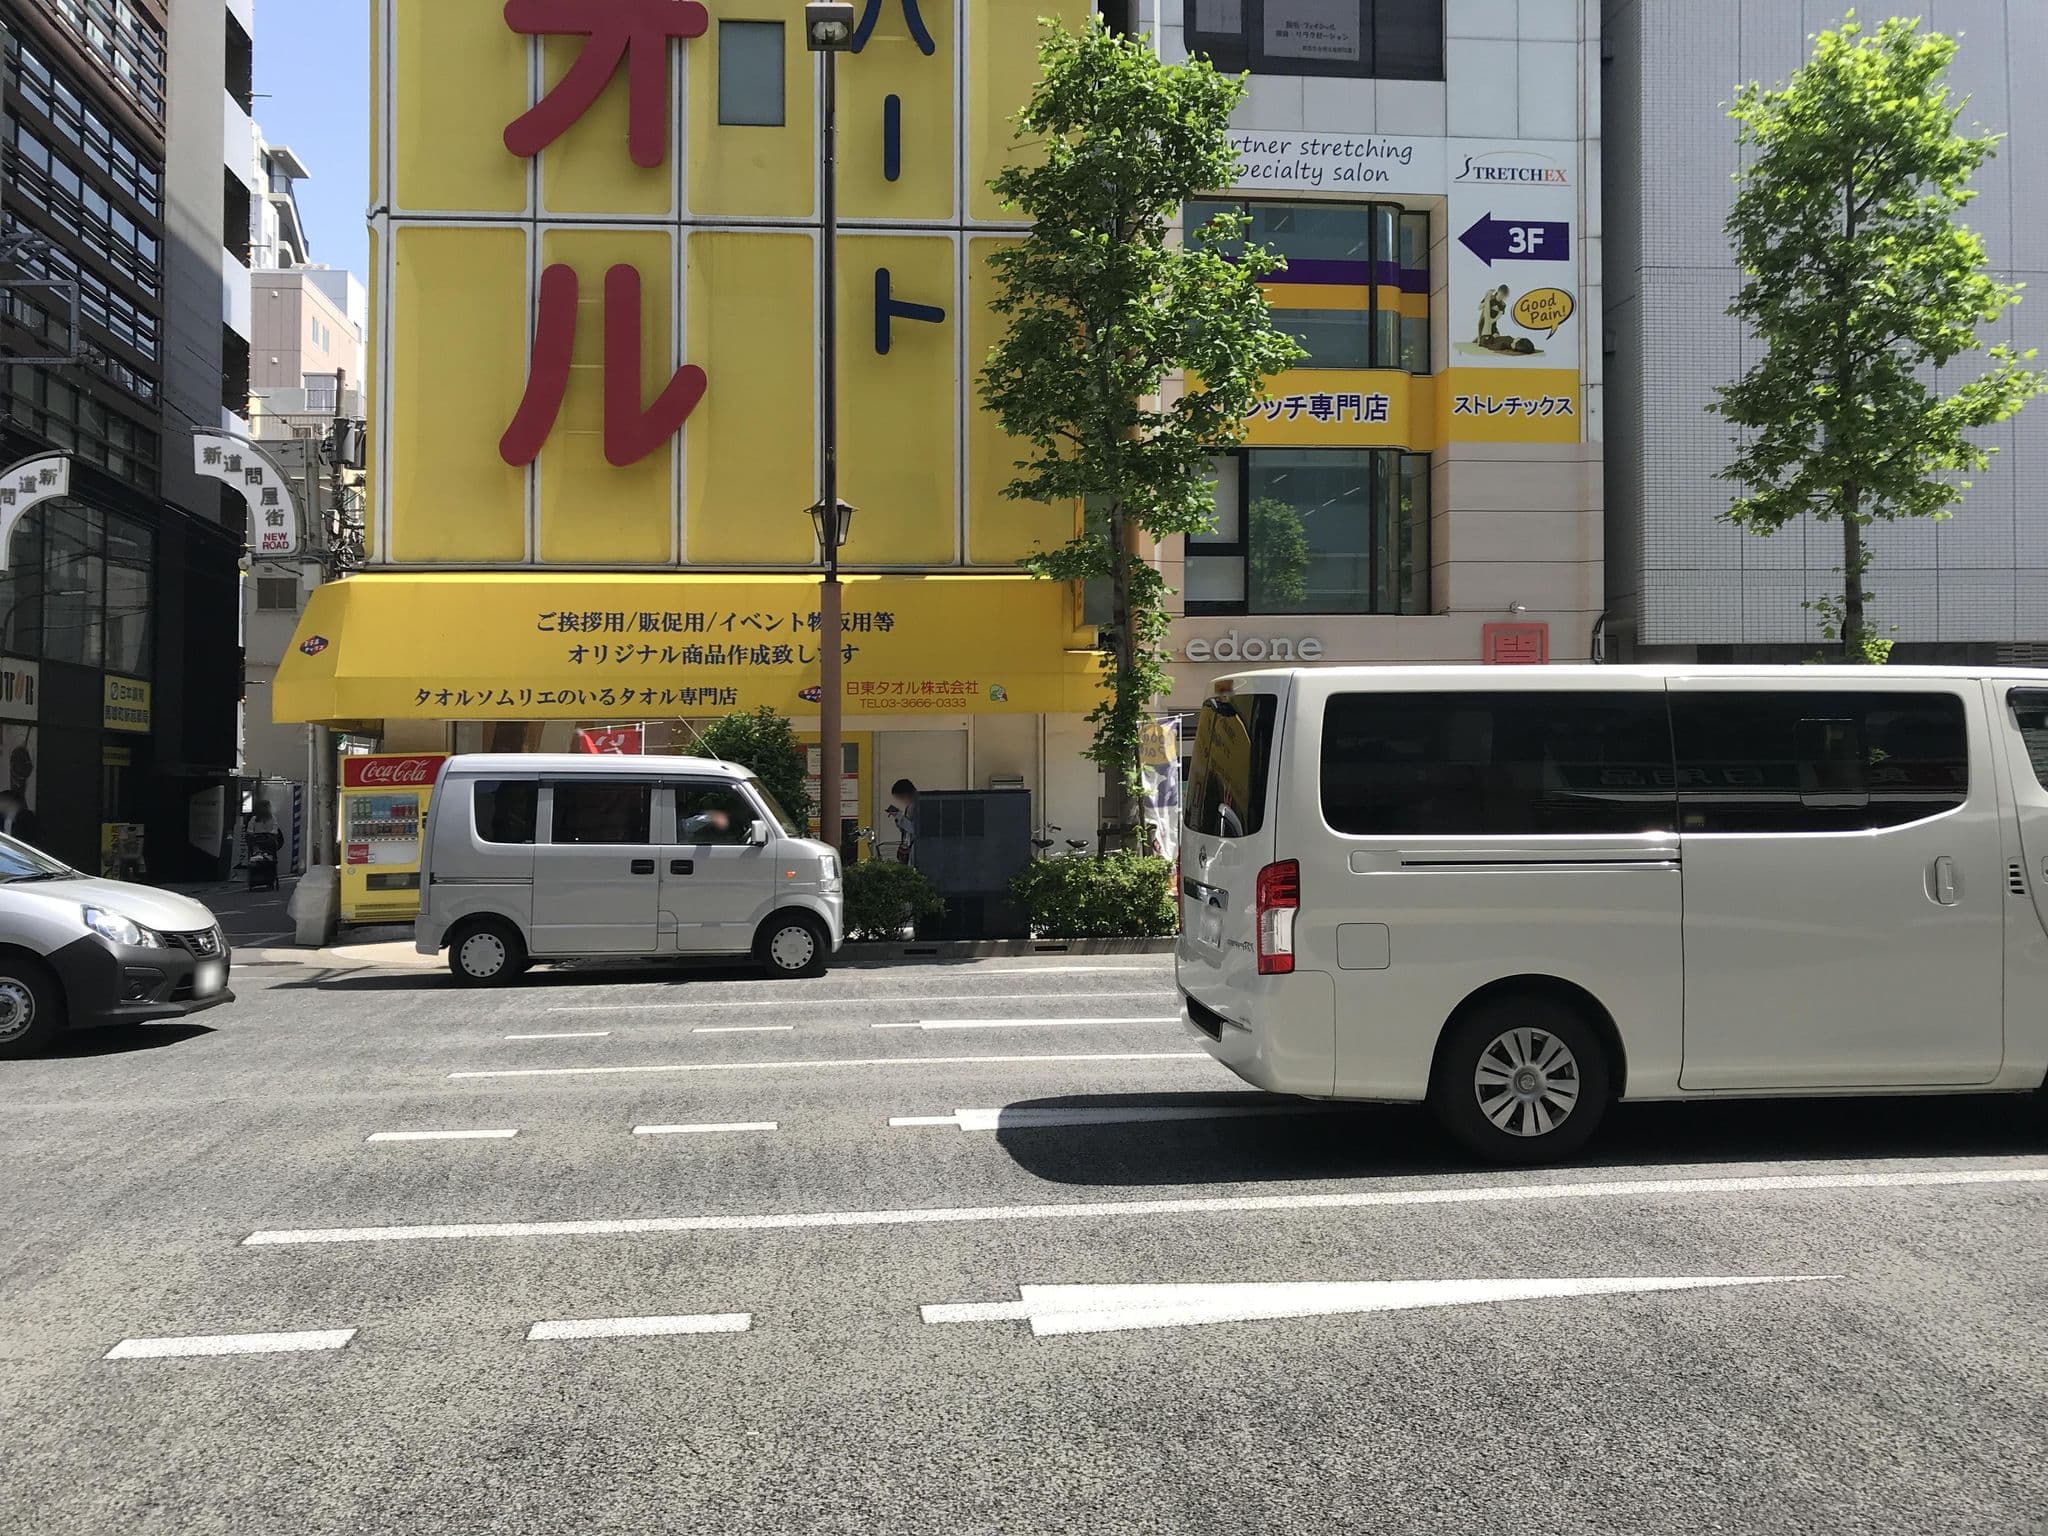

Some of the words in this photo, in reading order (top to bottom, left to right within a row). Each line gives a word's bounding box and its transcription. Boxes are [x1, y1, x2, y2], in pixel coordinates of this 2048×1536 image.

[1225, 135, 1293, 154] rtner
[1300, 138, 1414, 165] stretching
[1237, 159, 1323, 186] pecialty
[1333, 162, 1390, 183] salon
[1455, 156, 1567, 183] STRETCHEX
[1508, 226, 1545, 254] 3F
[1519, 293, 1557, 314] Good
[1530, 306, 1567, 325] Pain!
[1208, 393, 1389, 422] ッチ専門店
[1454, 395, 1574, 416] ストレチックス
[203, 445, 285, 528] 新道問屋街
[262, 540, 290, 551] ROAD
[263, 532, 287, 542] NEW
[568, 643, 860, 666] オリジナル商品作成致しす
[1185, 629, 1323, 663] edone
[414, 687, 738, 707] タオルソムリエのいるタオル専門店
[846, 680, 980, 696] 日東タオル株式会社
[860, 697, 967, 709] TEL03-3666-0333
[360, 759, 432, 783] Coca-Cola
